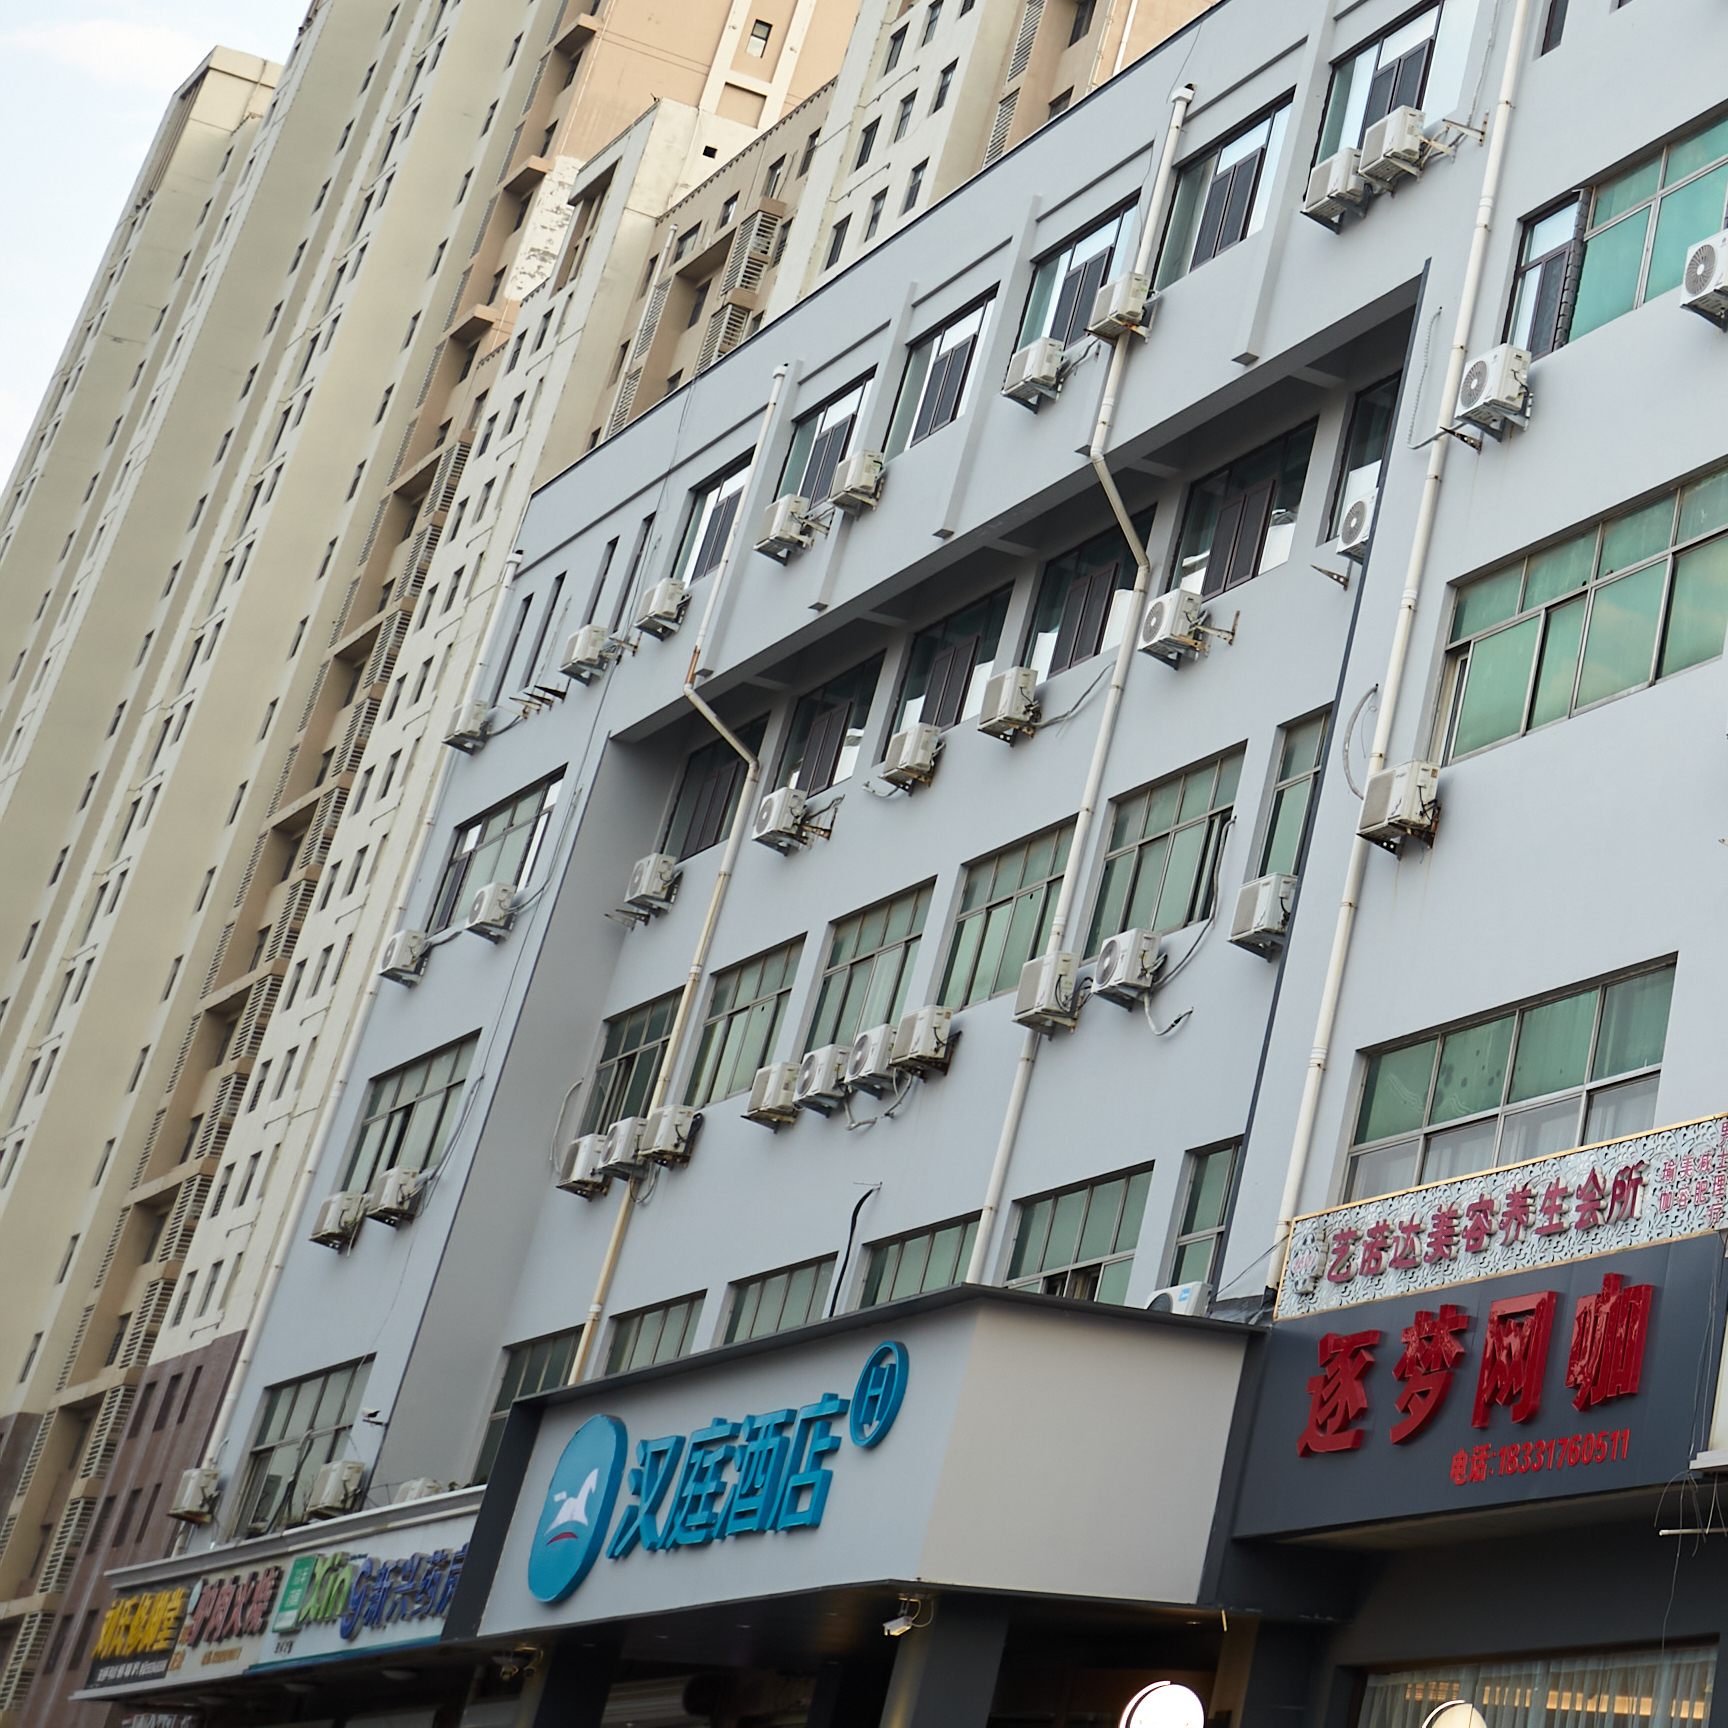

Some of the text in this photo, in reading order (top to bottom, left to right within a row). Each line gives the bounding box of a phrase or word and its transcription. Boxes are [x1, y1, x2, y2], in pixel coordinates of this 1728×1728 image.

[1296, 1273, 1654, 1458] 逐梦网咖
[606, 1392, 850, 1560] 汉庭酒店
[1450, 1428, 1632, 1486] 电话:18331760511
